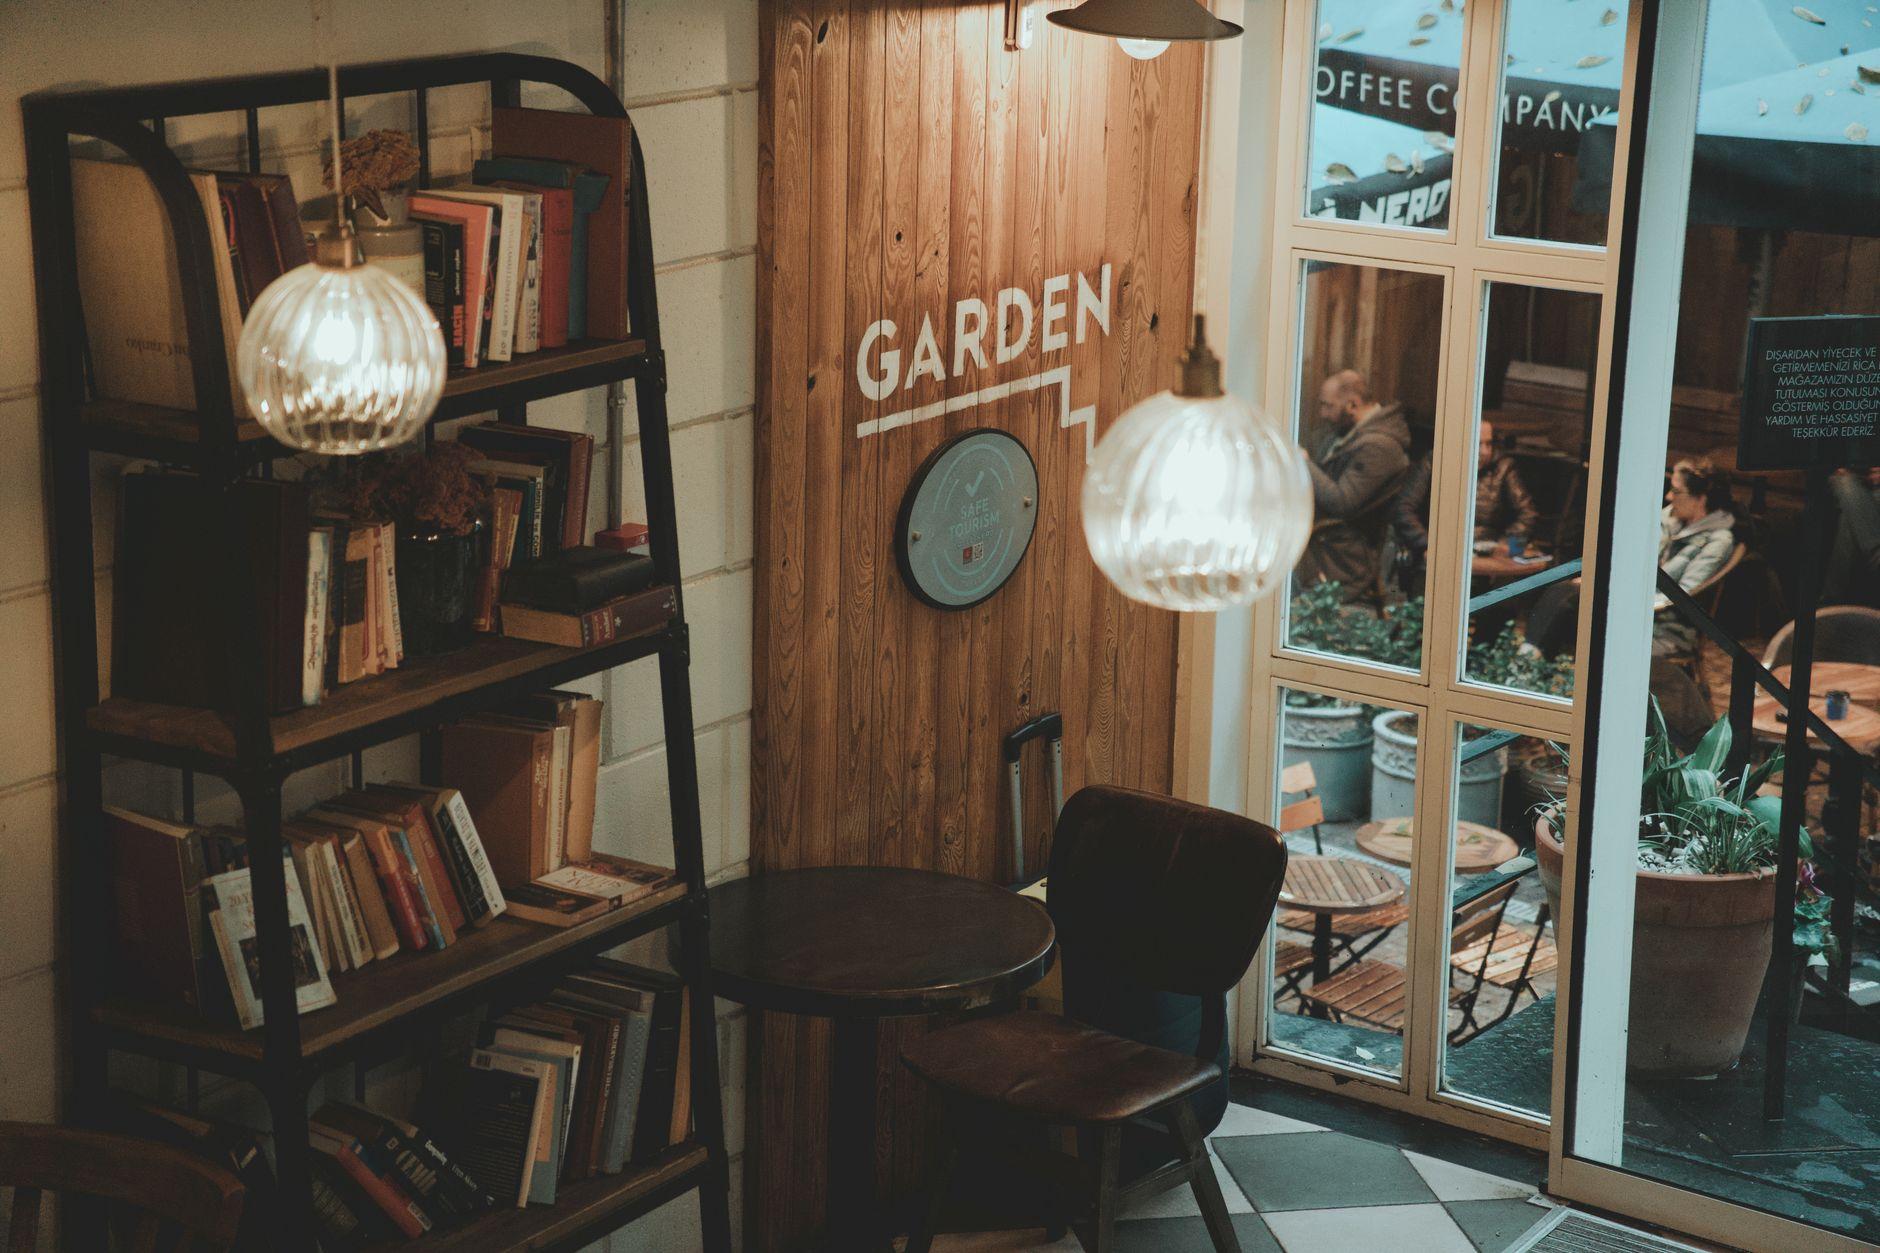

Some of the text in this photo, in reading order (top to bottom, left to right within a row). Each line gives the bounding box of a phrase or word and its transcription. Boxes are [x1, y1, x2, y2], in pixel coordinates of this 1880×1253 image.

[1426, 82, 1611, 132] CPANY
[1358, 178, 1451, 226] NERO
[857, 263, 1112, 401] GARDEN
[1765, 346, 1876, 361] DIŞARIDAN YİYECEK VE
[1852, 358, 1876, 371] RİCA
[1775, 388, 1828, 400] TUTULMASI
[1765, 415, 1803, 426] YARDIM
[1805, 414, 1818, 425] VE
[1792, 425, 1839, 439] TEŞEKKÜR
[960, 497, 990, 520] SAFE
[949, 511, 1000, 537] TOURISM
